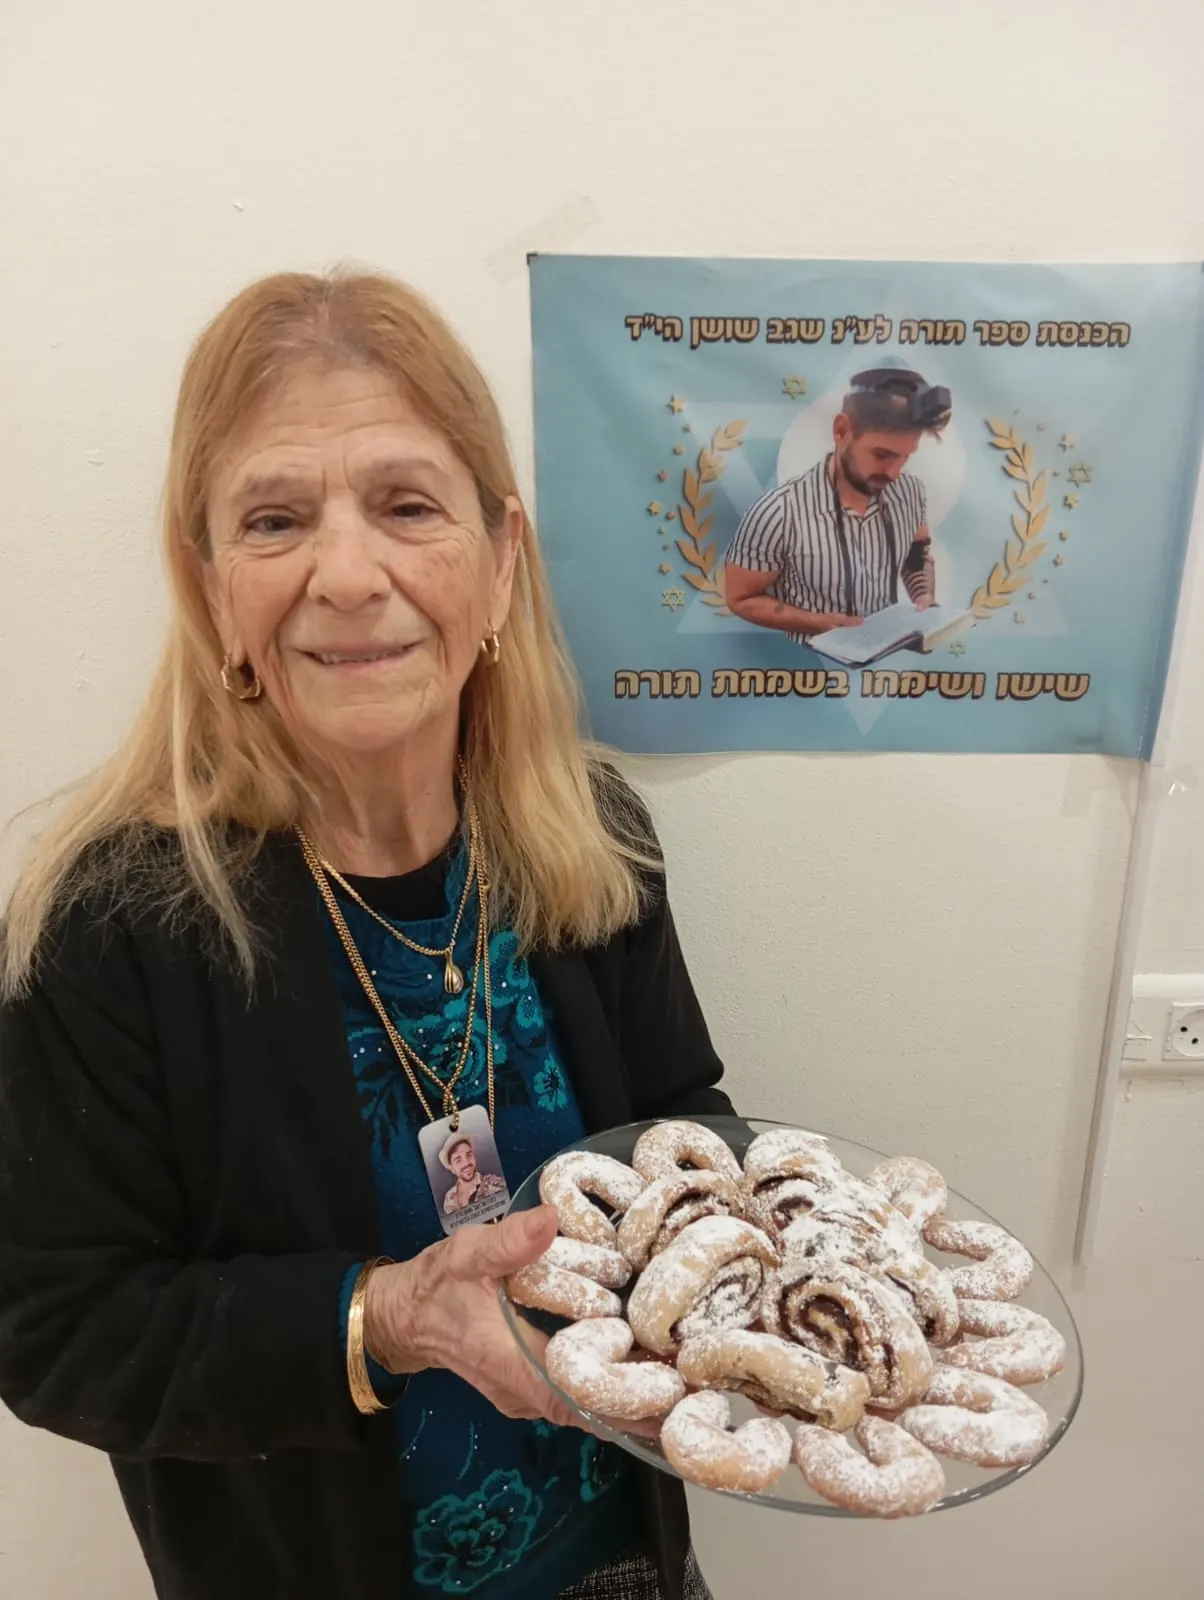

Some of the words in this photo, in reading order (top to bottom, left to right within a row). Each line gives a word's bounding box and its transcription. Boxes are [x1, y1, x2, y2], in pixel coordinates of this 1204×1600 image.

[690, 316, 760, 350] שושן
[766, 317, 824, 344] שגב
[898, 319, 966, 345] תורה
[973, 319, 1031, 346] ספר
[1036, 320, 1131, 348] הכנסת
[614, 669, 702, 699] תורה
[711, 668, 849, 698] בשמחת
[861, 669, 986, 700] ושימחו
[995, 672, 1091, 701] שישו
